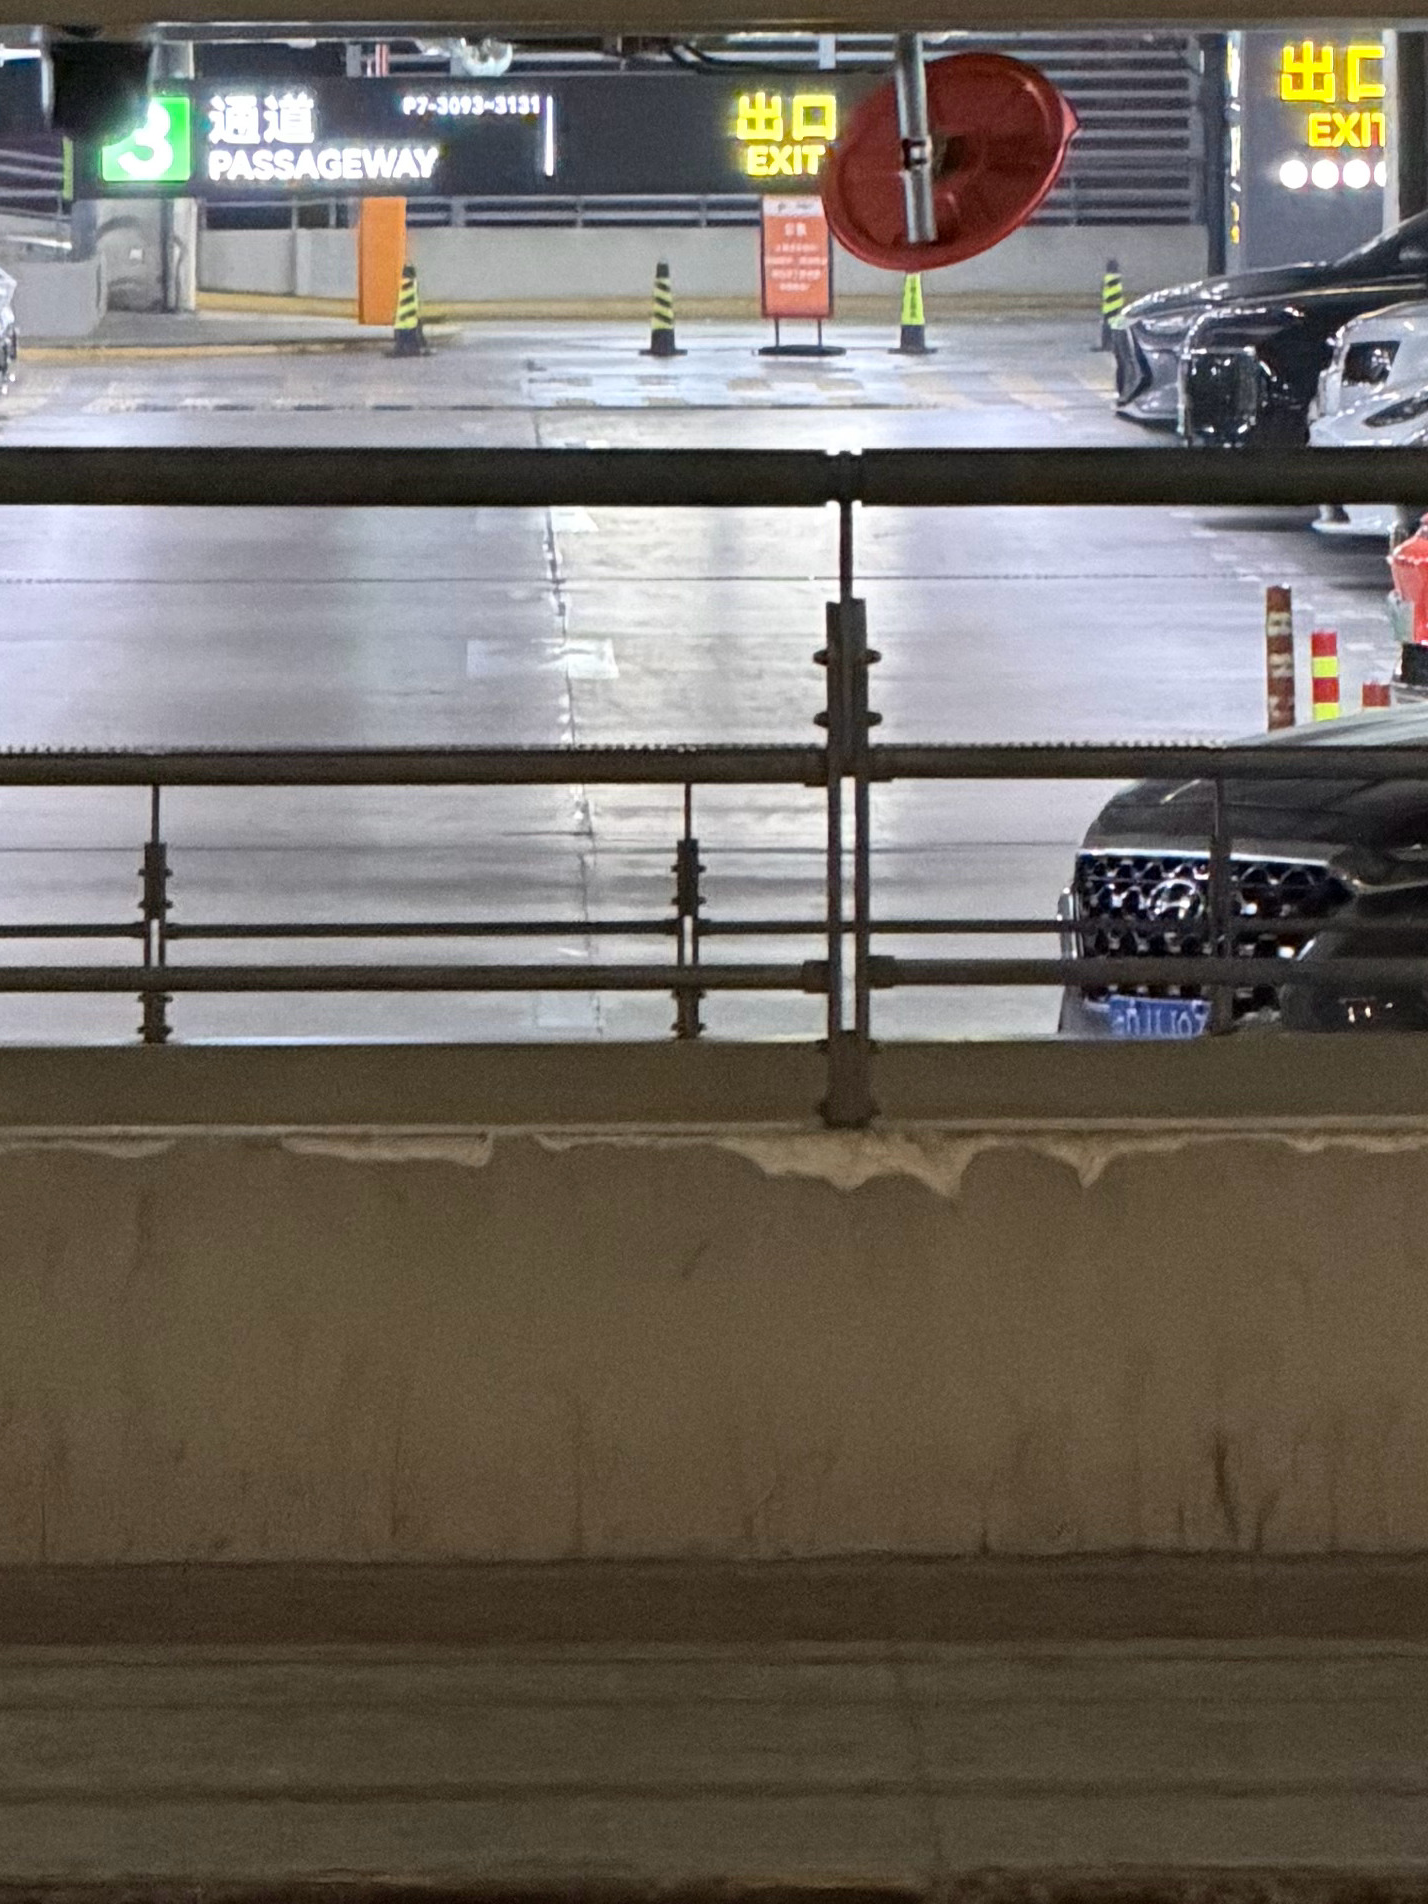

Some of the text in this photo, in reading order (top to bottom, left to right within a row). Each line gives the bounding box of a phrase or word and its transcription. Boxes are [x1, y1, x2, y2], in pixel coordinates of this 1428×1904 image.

[1280, 39, 1386, 104] 出口
[117, 98, 174, 181] 3
[208, 92, 317, 145] 通道
[735, 90, 838, 142] 出口
[1308, 111, 1386, 148] EXIT
[208, 148, 440, 182] PASSAGEWAY
[746, 144, 826, 178] EXIT
